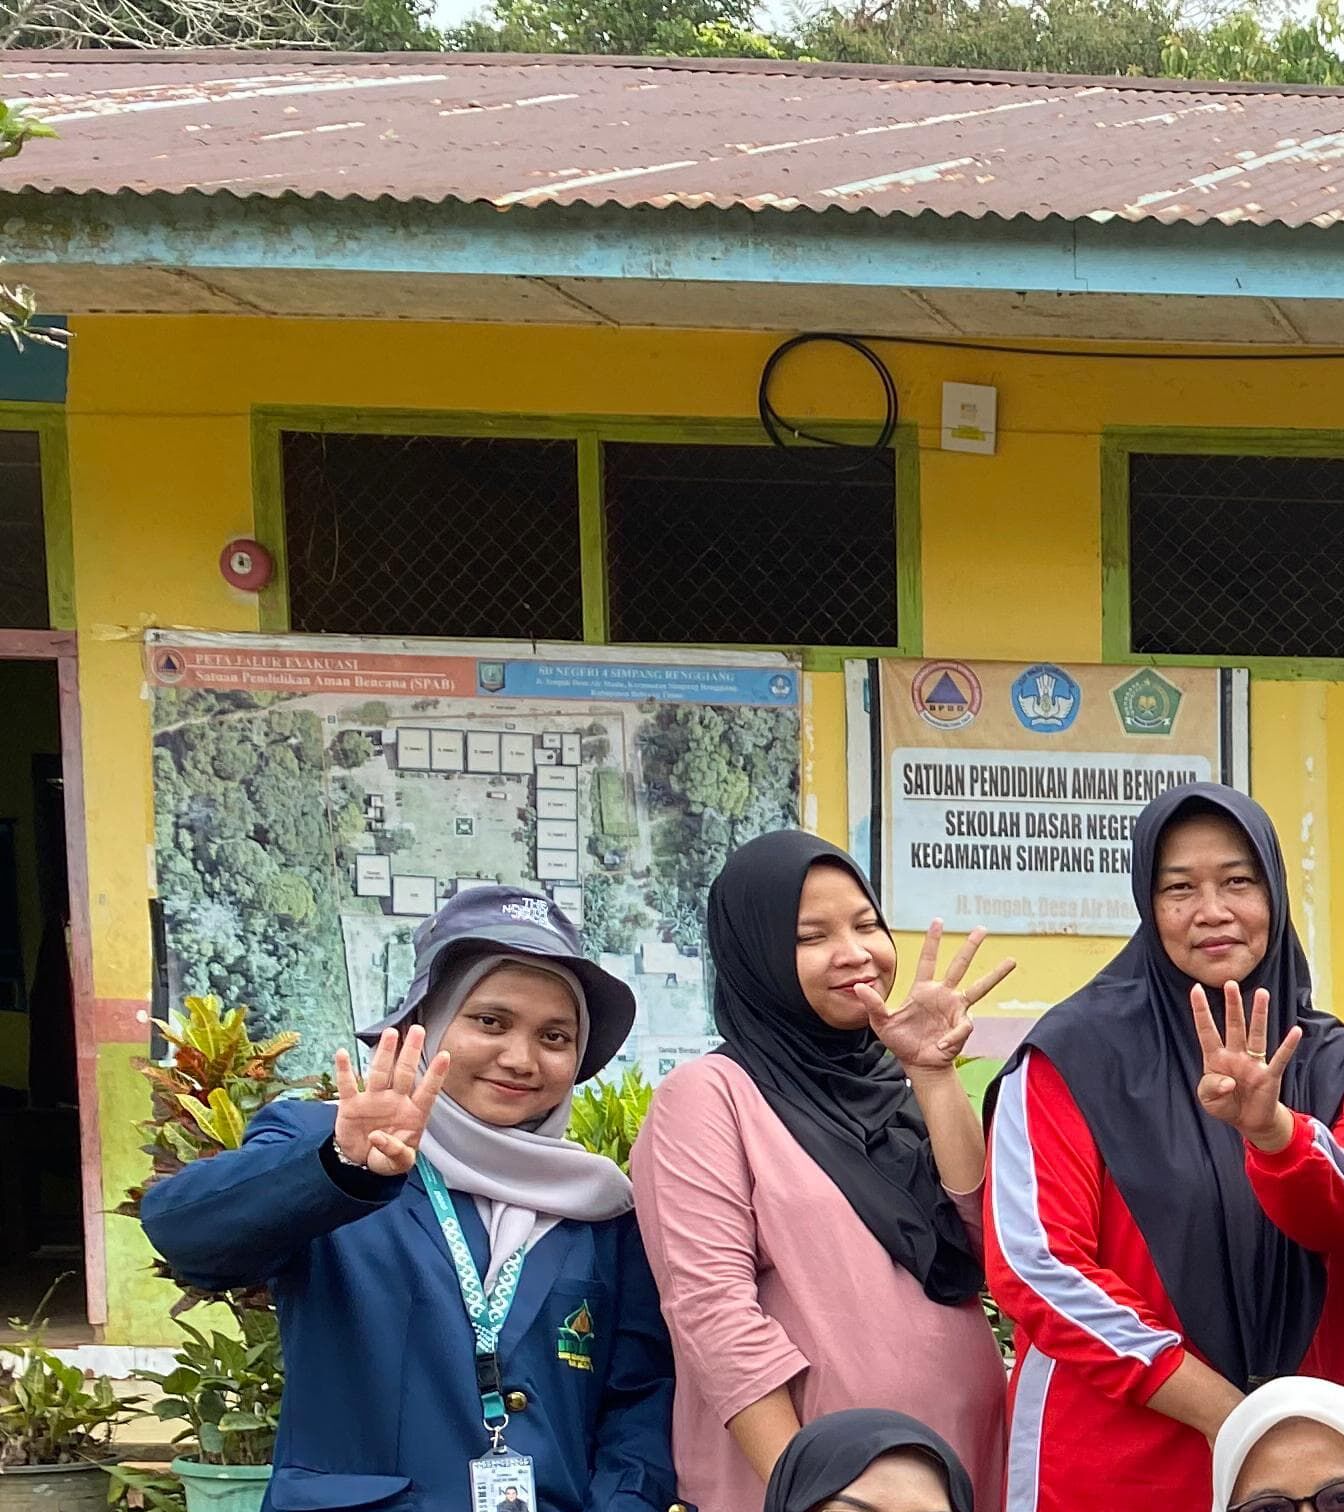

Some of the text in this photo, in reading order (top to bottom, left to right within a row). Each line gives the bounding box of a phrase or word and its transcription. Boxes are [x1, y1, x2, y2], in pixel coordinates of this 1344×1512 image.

[195, 653, 232, 667] PETA
[195, 671, 455, 692] Satuan Pendidikan Aman Bencana (SPAB)
[555, 666, 599, 678] NEGERI
[610, 669, 662, 680] SIMPANG
[665, 671, 736, 682] RENGGIANG
[903, 763, 965, 796] SATUAN
[970, 766, 1068, 799] PENDIDIKAN
[1071, 768, 1119, 800] AMAN
[945, 810, 1020, 837] SEKOLAH
[1026, 815, 1082, 840] DASAR
[911, 843, 1012, 870] KECAMATAN
[1016, 846, 1094, 874] SIMPANG
